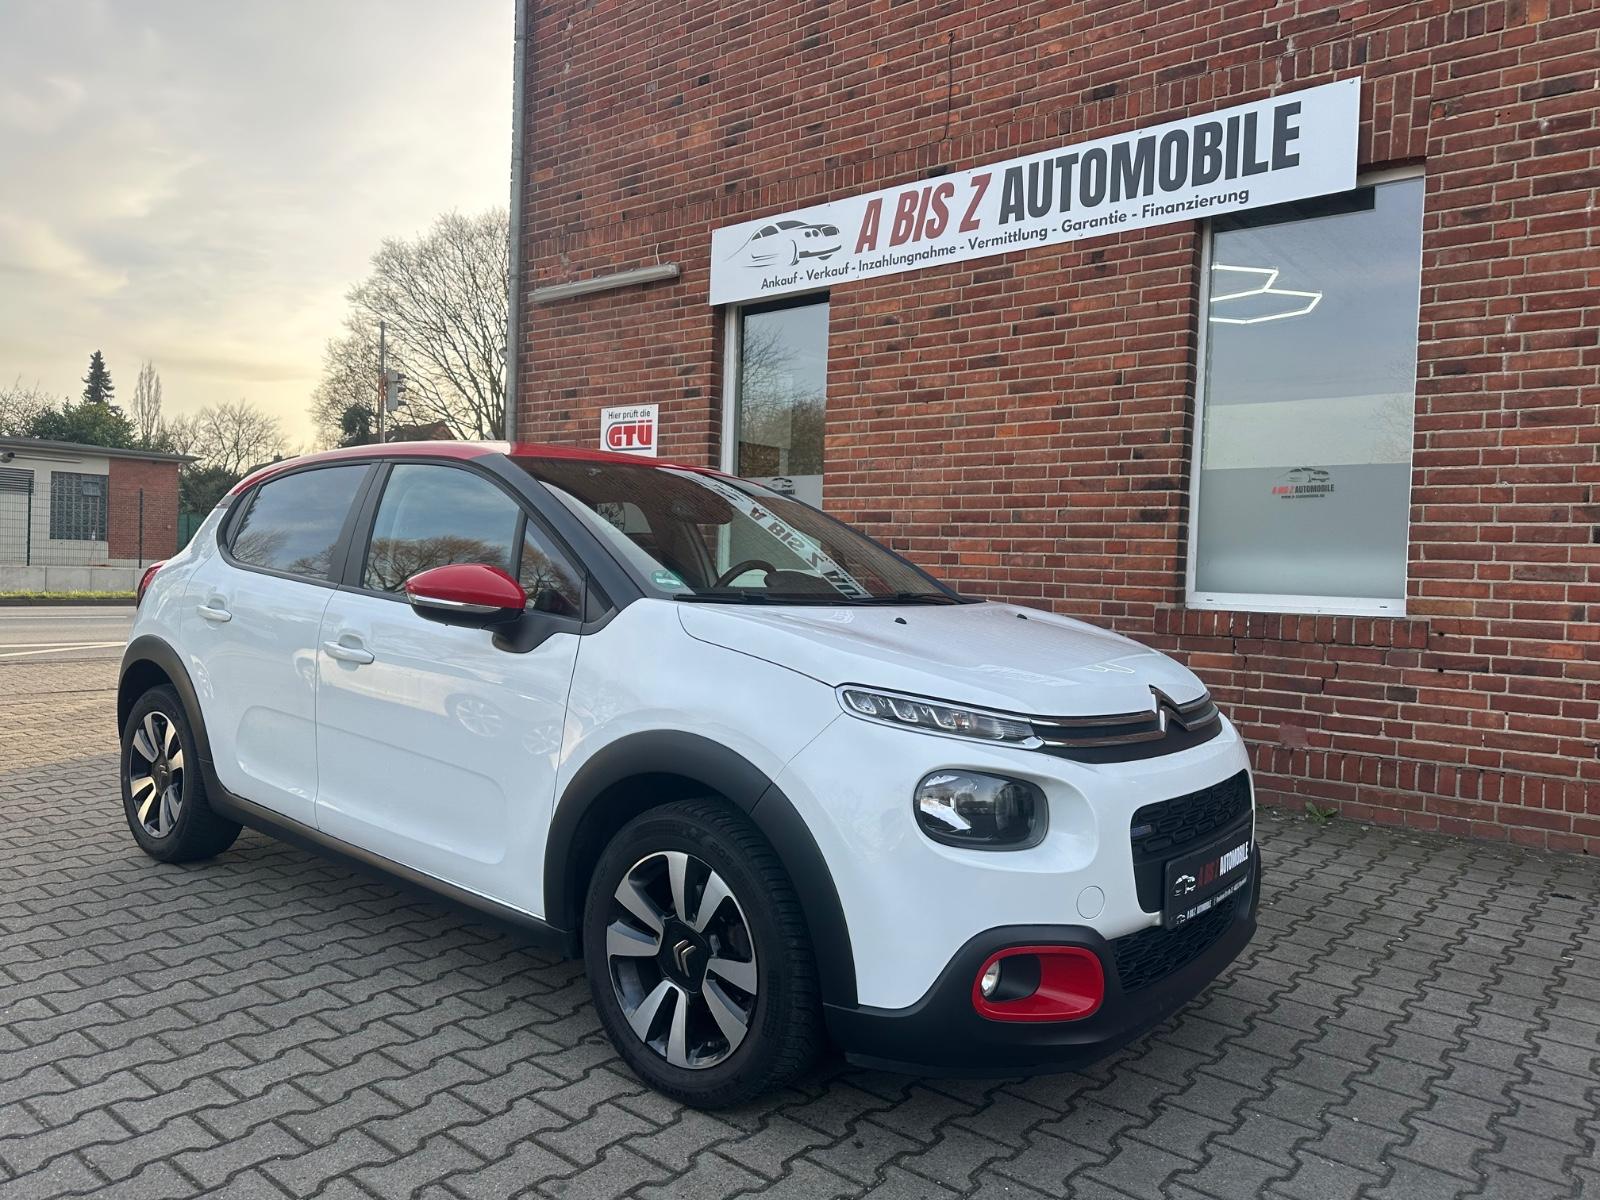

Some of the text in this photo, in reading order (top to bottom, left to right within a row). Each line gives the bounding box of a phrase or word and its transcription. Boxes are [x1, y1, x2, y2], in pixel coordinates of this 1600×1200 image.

[854, 101, 1301, 254] A BIS Z AUTOMOBILE
[761, 271, 798, 289] Ankauf
[806, 263, 850, 281] Verkauf
[858, 245, 956, 272] Inzahlungnahme
[968, 226, 1048, 250] Vermittlung
[1061, 211, 1127, 233] Garantie
[1142, 189, 1249, 219] Finanzierung
[608, 409, 651, 420] Hier prüft die
[609, 419, 653, 447] GTÜ
